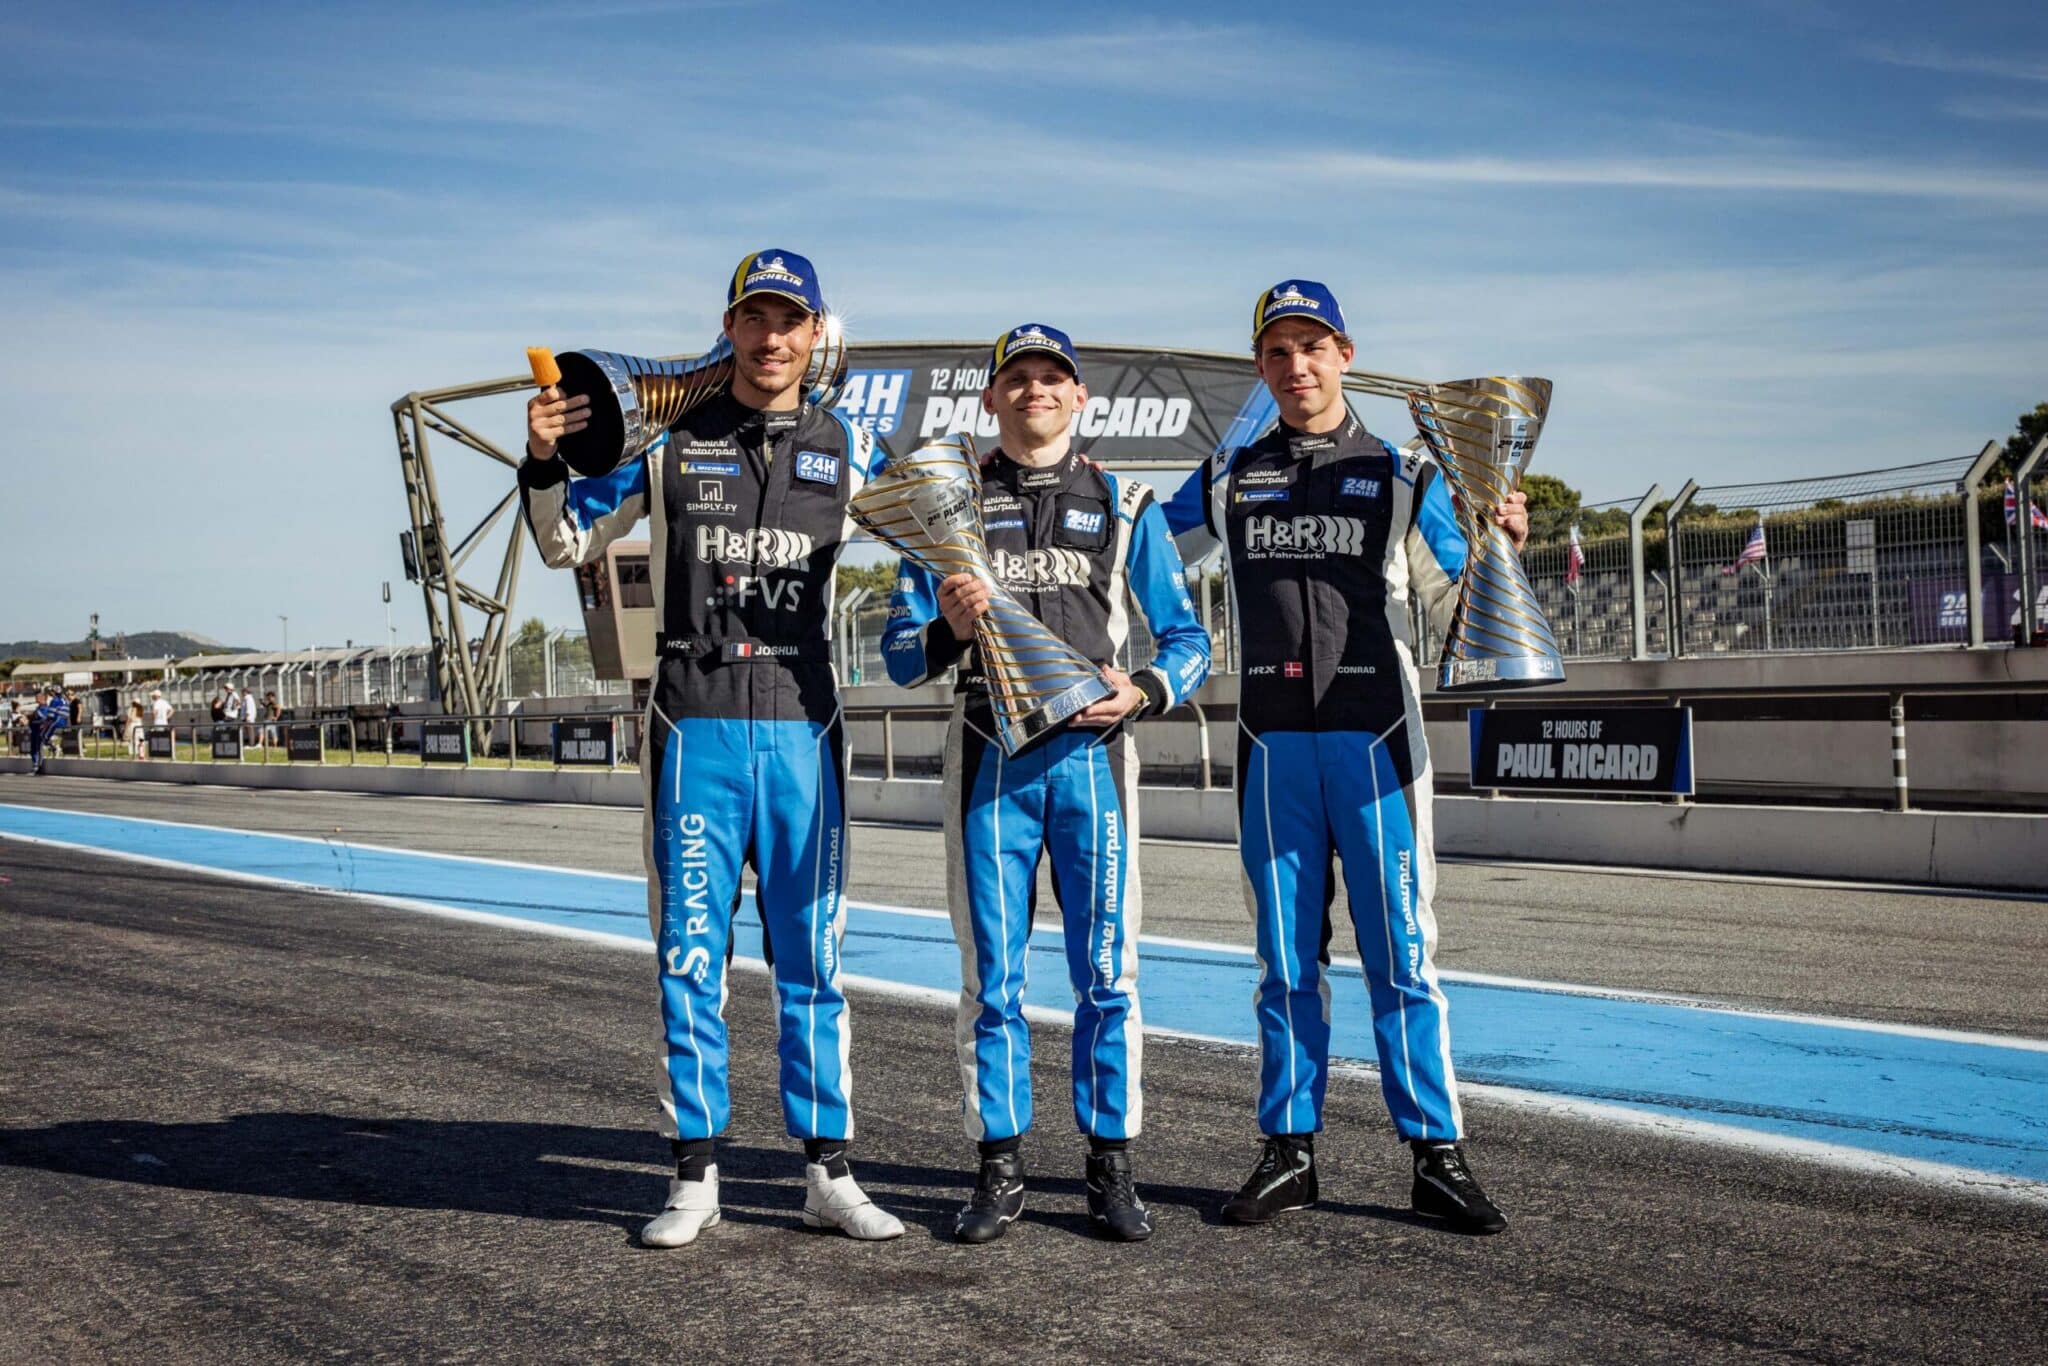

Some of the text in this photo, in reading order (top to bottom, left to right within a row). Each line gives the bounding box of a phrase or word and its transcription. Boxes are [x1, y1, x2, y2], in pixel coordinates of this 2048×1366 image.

[745, 271, 803, 287] MICHELIN
[1264, 299, 1320, 317] MICHELIN
[1005, 337, 1062, 353] MICHELIN
[931, 368, 990, 391] 12 HOU
[836, 374, 904, 415] 4H
[919, 396, 1192, 437] PAU ICARD
[682, 447, 737, 456] motorsport
[800, 455, 836, 475] 24H
[801, 470, 835, 482] SERIES
[1239, 476, 1288, 485] motorsport
[1345, 479, 1379, 492] 24H
[686, 503, 737, 512] SIMPLY-FY
[1066, 509, 1102, 527] 24H
[1245, 515, 1325, 551] H&R
[698, 525, 777, 566] H&R
[738, 576, 804, 612] FVS
[754, 646, 799, 656] JOSHUA
[1249, 665, 1277, 675] HRX
[1337, 666, 1376, 674] CONRAD
[1542, 721, 1603, 739] 12 HOURS OF
[1497, 743, 1659, 780] PAUL RICARD
[825, 826, 839, 915] motorsport
[1104, 810, 1121, 913] motorsport
[660, 812, 679, 937] SPIRIT OF
[679, 813, 709, 936] RACING
